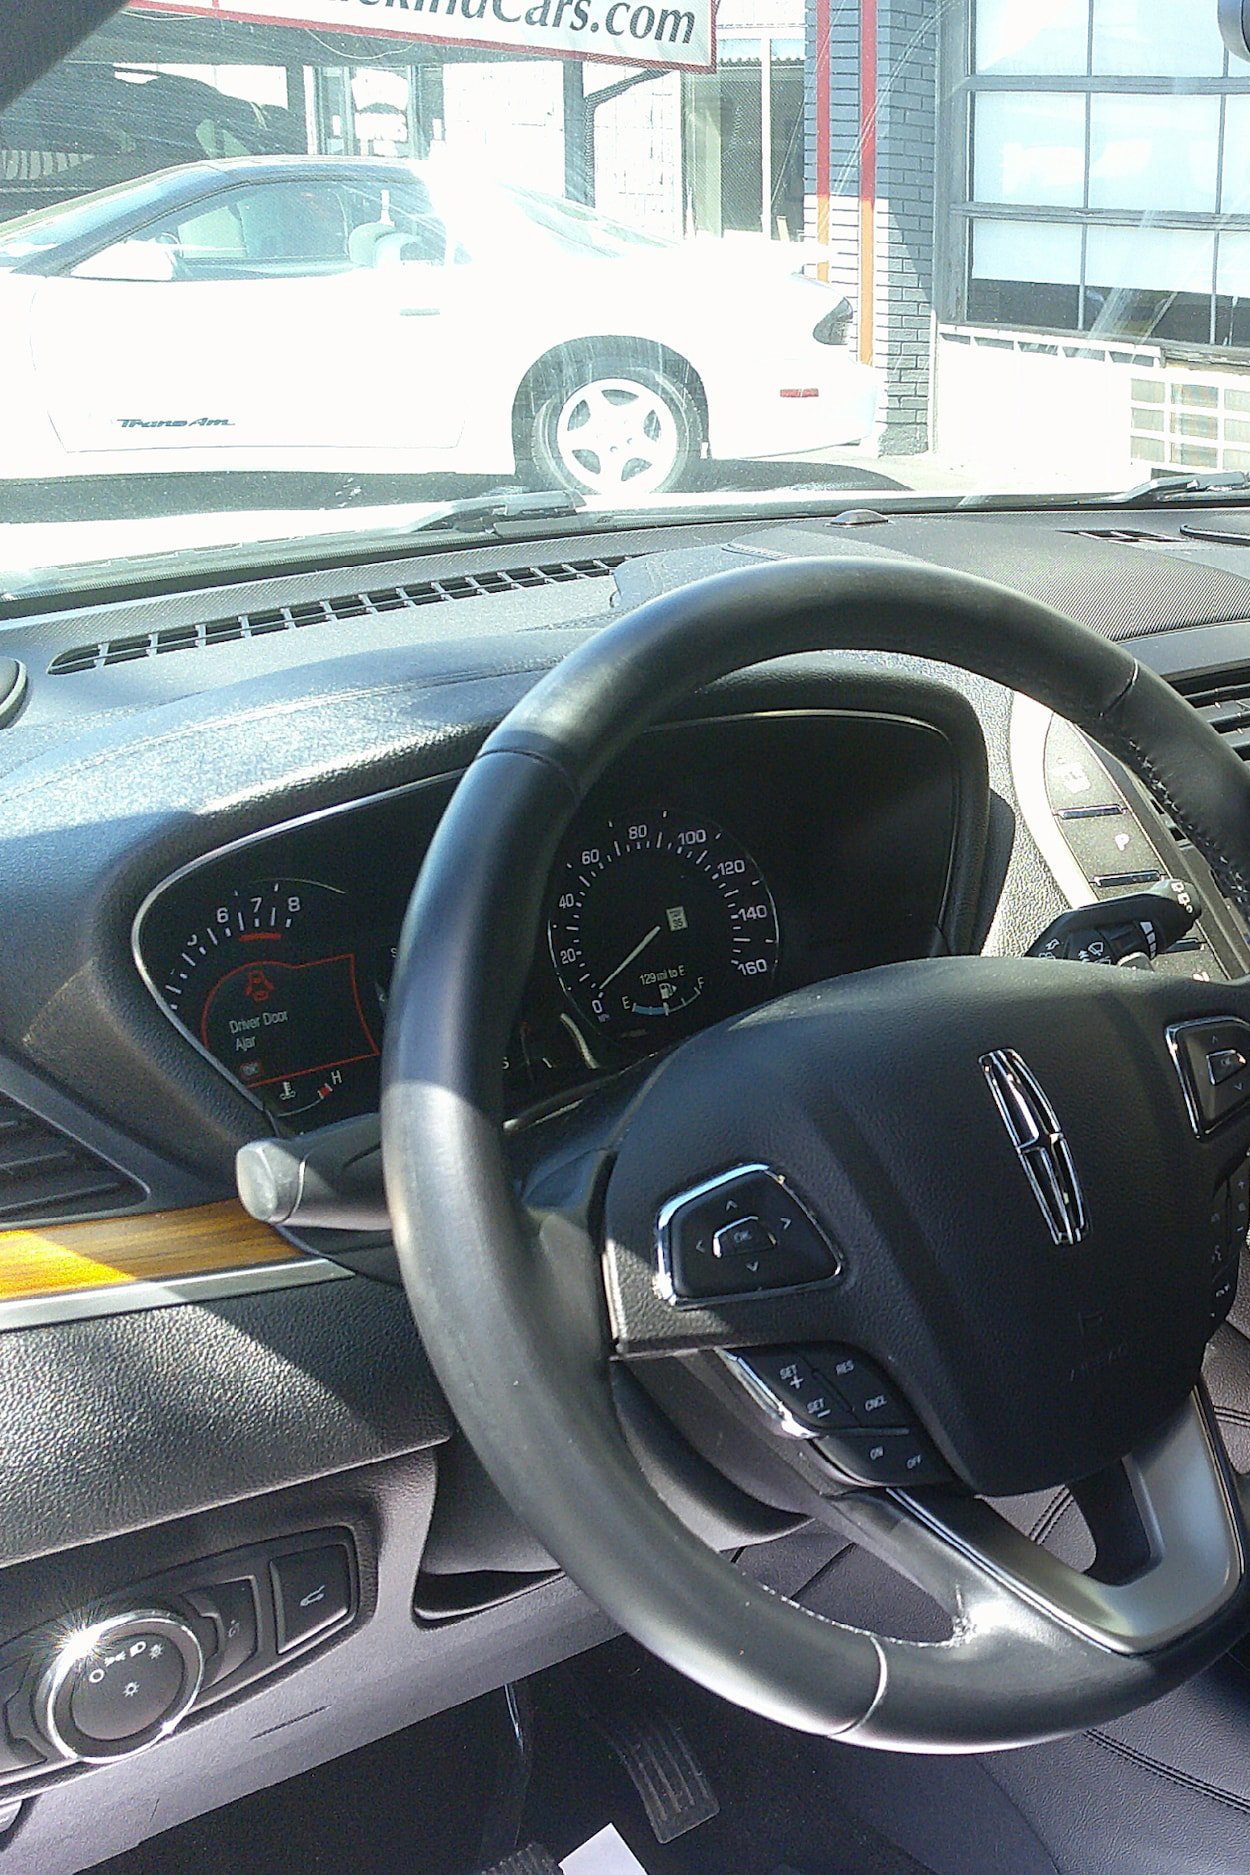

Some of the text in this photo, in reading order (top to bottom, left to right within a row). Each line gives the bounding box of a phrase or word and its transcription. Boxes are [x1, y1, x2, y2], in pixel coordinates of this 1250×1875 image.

[117, 417, 236, 428] Trans Am
[628, 824, 648, 839] 80
[677, 829, 707, 845] 100
[581, 849, 600, 865] 60
[718, 859, 746, 875] 120
[251, 897, 264, 914] 7
[288, 896, 301, 912] 8
[558, 893, 576, 909] 40
[217, 907, 230, 923] 6
[738, 905, 768, 922] 140
[560, 947, 577, 964] 20
[737, 958, 768, 976] 160
[639, 972, 657, 984] 129
[697, 976, 706, 990] F
[591, 998, 604, 1015] 0
[622, 995, 631, 1010] E
[229, 1008, 289, 1034] Driver Door
[331, 1071, 343, 1086] H
[780, 1365, 798, 1380] SET
[836, 1360, 855, 1376] RES
[806, 1398, 825, 1415] SET
[905, 1454, 923, 1470] OFF
